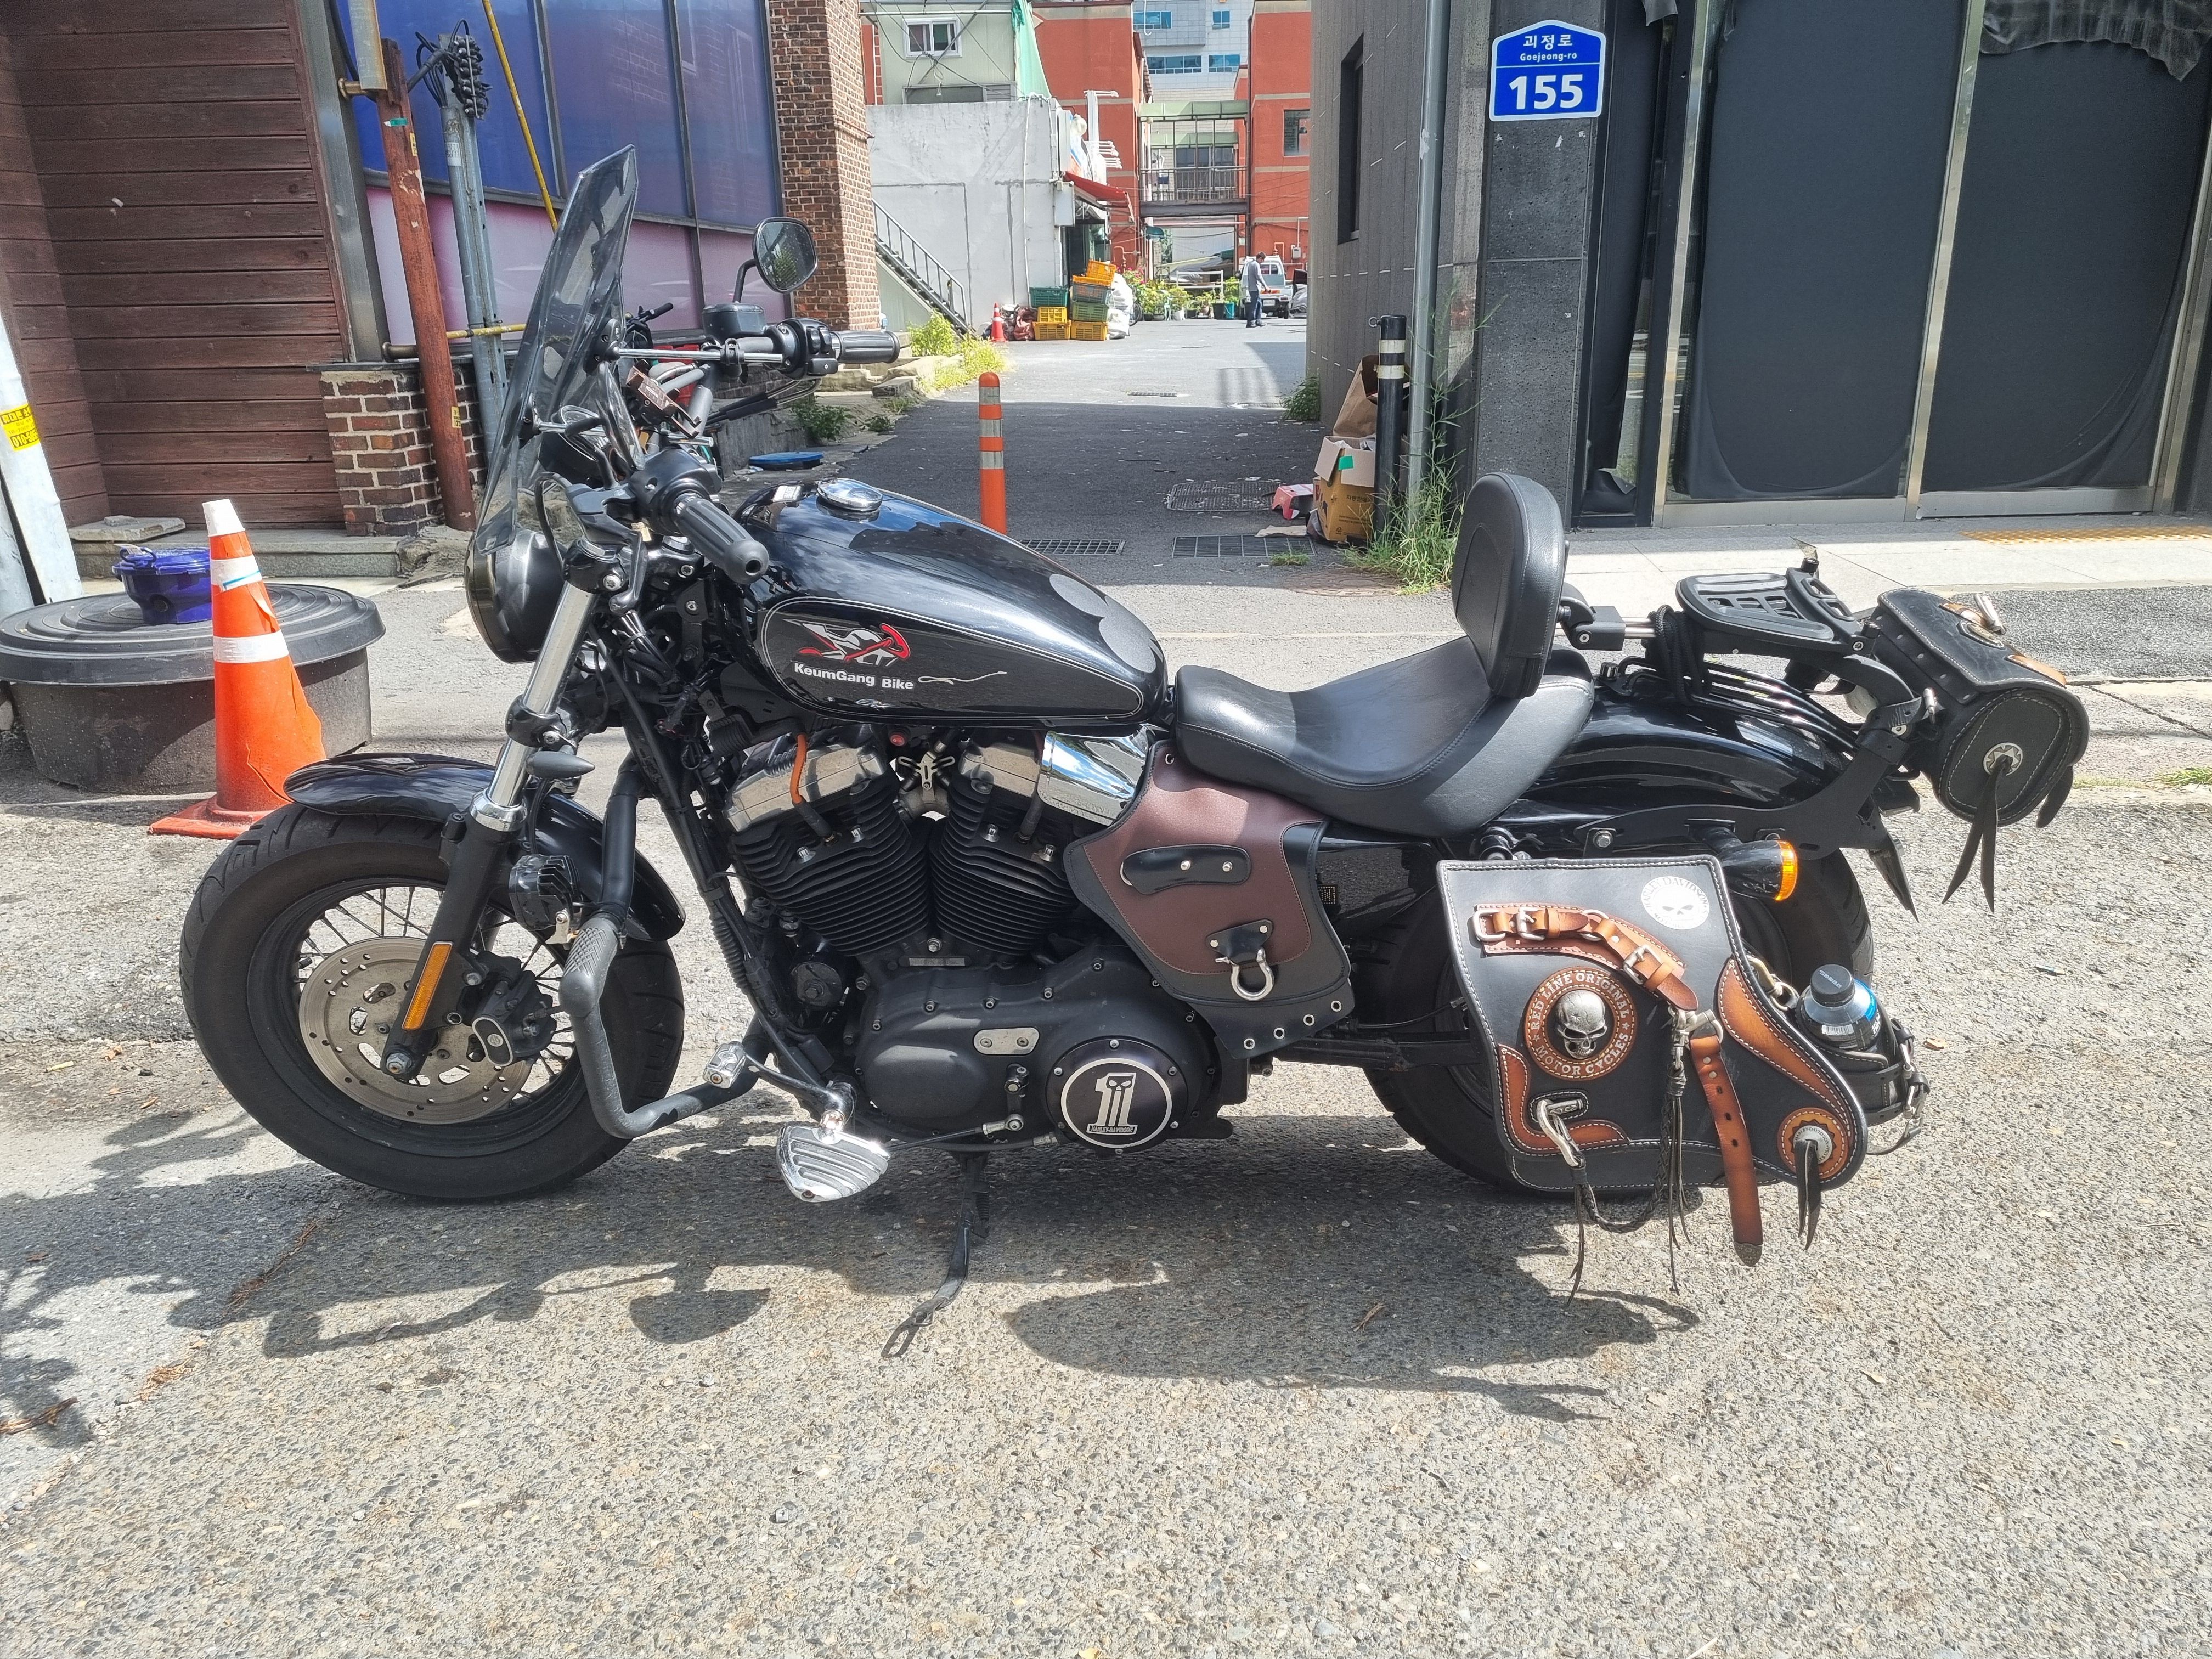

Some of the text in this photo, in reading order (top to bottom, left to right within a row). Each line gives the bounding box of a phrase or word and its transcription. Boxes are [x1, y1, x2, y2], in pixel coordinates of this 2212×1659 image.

[1523, 34, 1573, 50] 괴정로
[1520, 52, 1577, 63] Goejeong-ro
[1509, 74, 1583, 110] 155
[794, 662, 914, 690] KeumGang Bike
[1662, 877, 1709, 905] DAVIDSON
[1531, 972, 1630, 1030] RED LINE ORIGINAL
